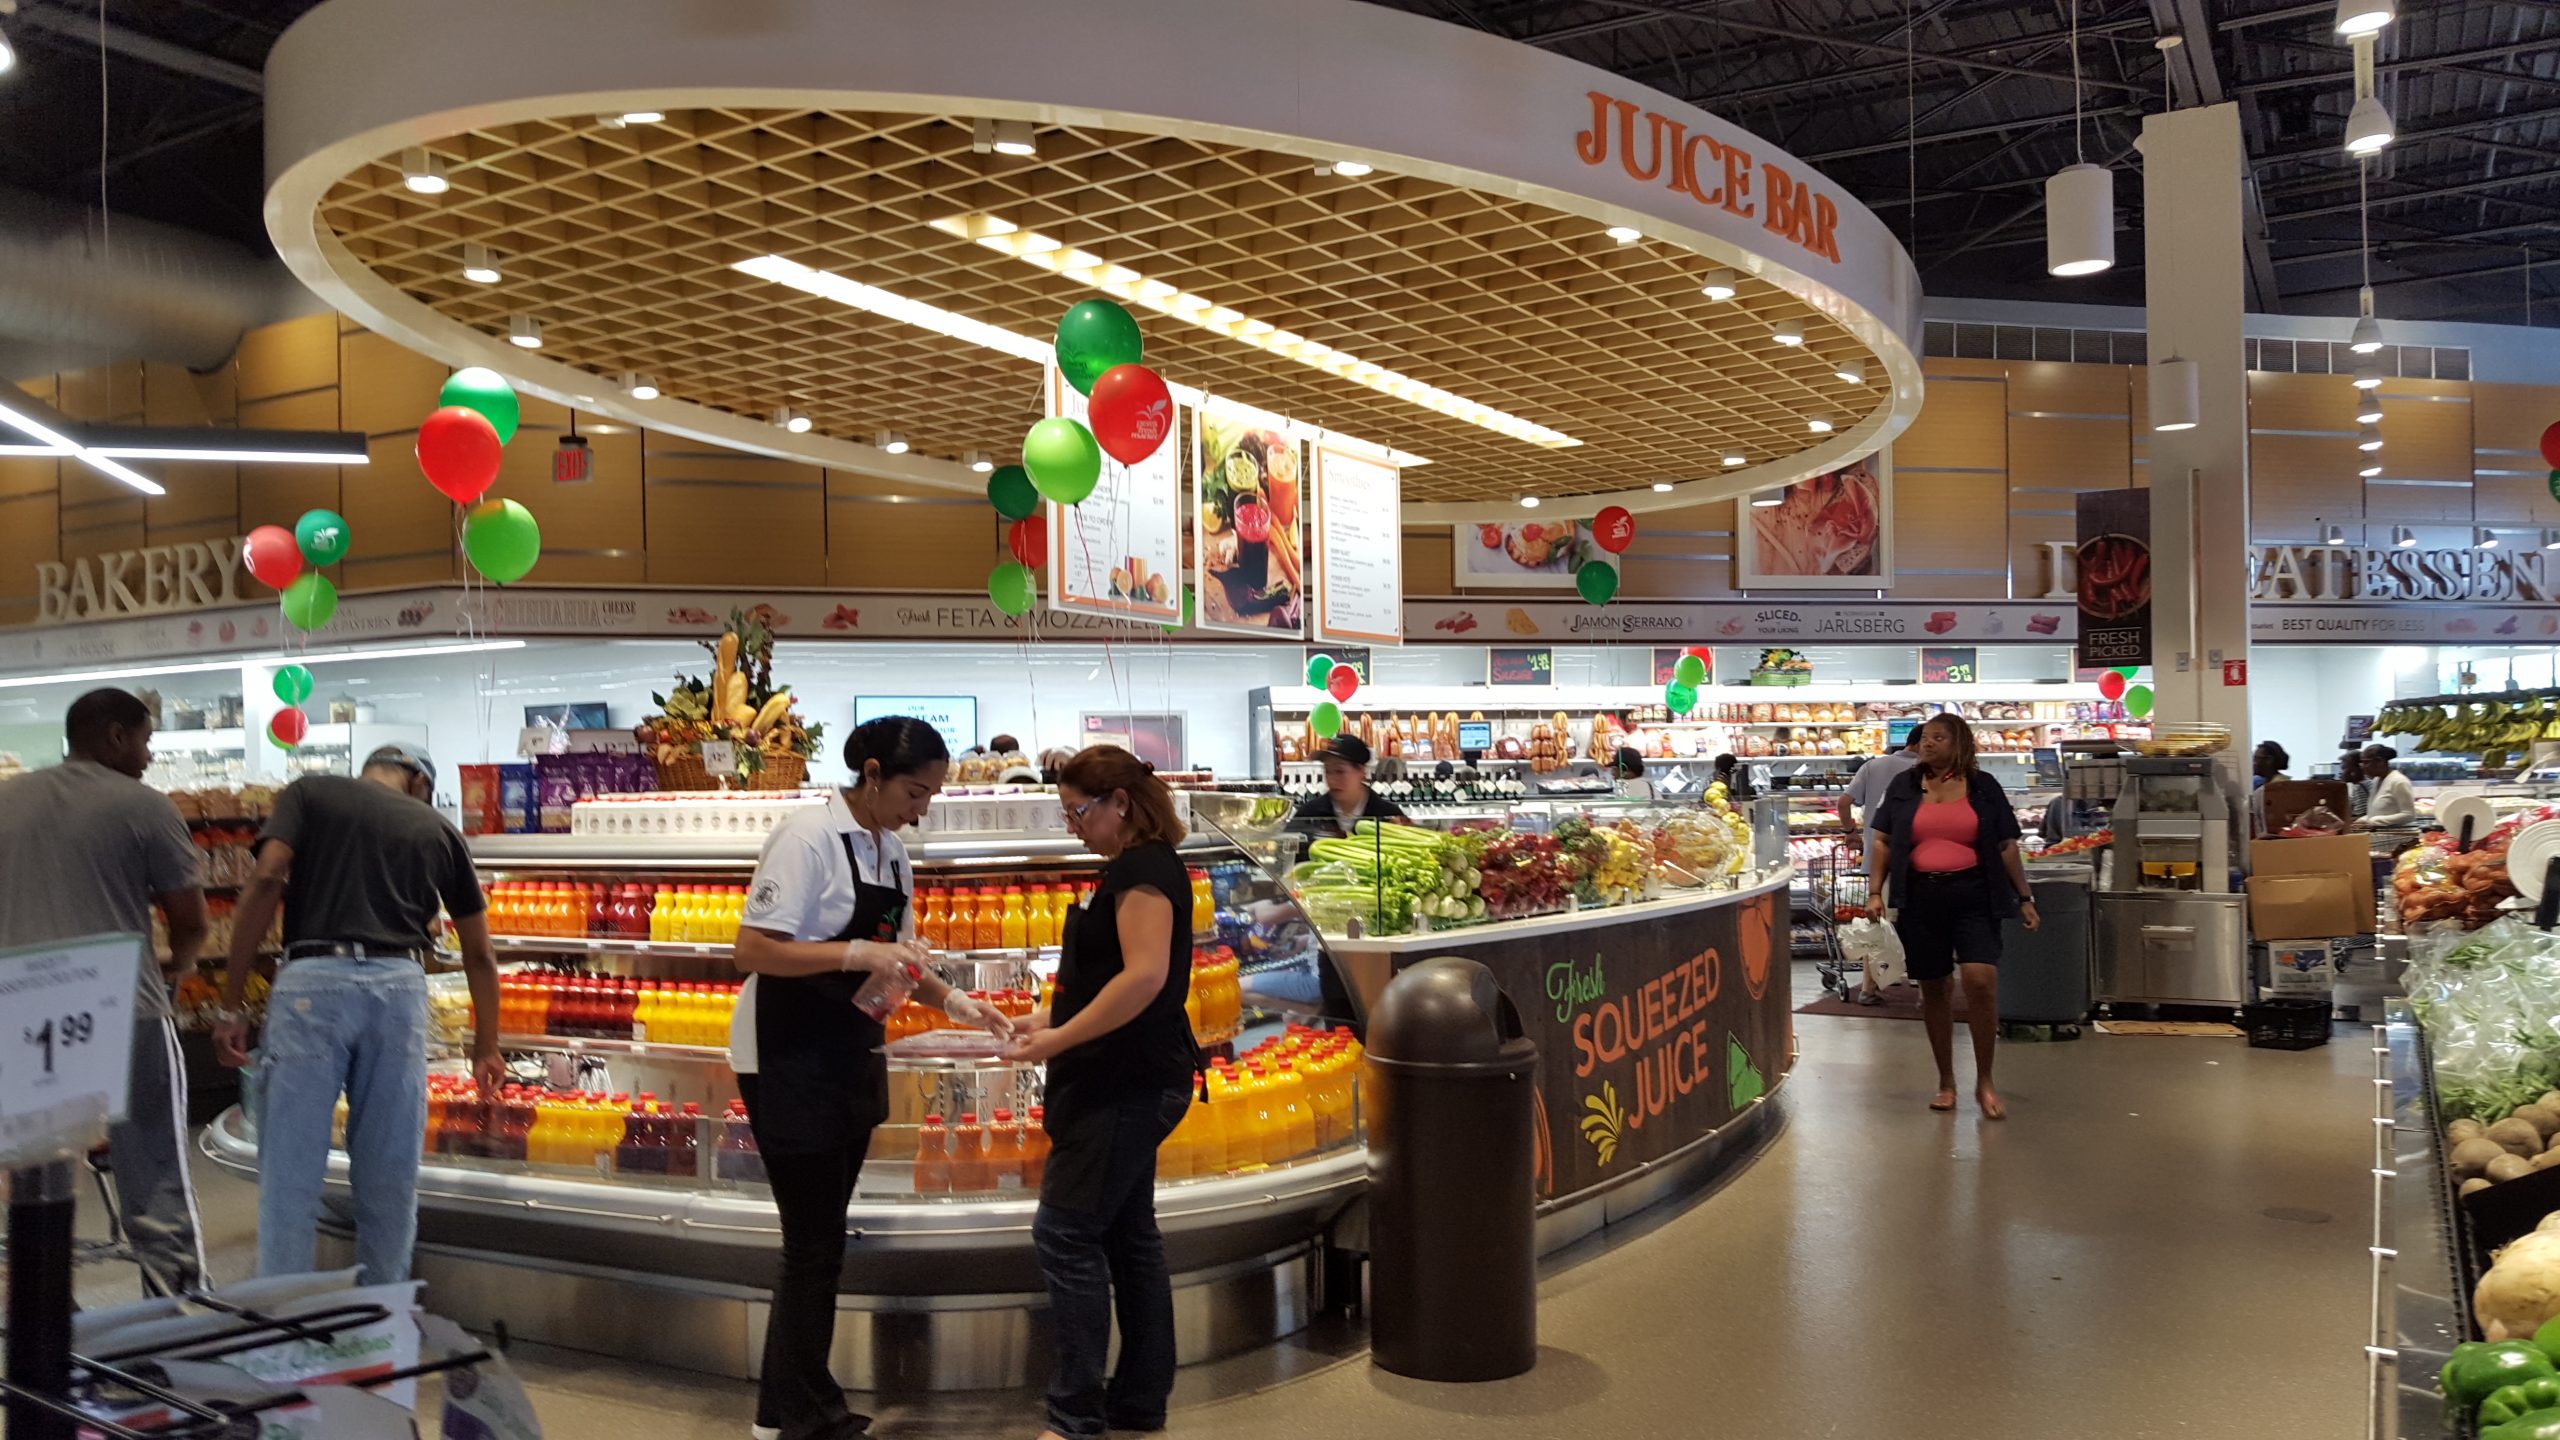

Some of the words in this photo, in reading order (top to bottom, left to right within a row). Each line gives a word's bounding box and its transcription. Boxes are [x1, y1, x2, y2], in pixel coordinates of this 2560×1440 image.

[1576, 91, 1754, 218] JUICE
[1761, 162, 1842, 264] BAR
[557, 448, 584, 481] EXIT
[34, 536, 250, 624] BAKERY
[2249, 545, 2556, 601] ATESSEN
[937, 607, 996, 627] FETA
[1003, 610, 1020, 628] &
[1622, 614, 1683, 632] SERRANO
[1758, 625, 1776, 634] YOUR
[1777, 625, 1799, 634] LIKING
[1814, 618, 1905, 633] JARLSBERG
[2282, 618, 2312, 631] BEST
[2316, 618, 2370, 631] QUALITY
[2371, 619, 2396, 631] FOR
[2400, 619, 2425, 631] LESS
[2089, 631, 2141, 645] FRESH
[2090, 644, 2141, 658] PICKED
[1546, 952, 1605, 1024] Fresh
[1573, 947, 1721, 1078] SQUEEZED
[1628, 1020, 1709, 1130] JUICE
